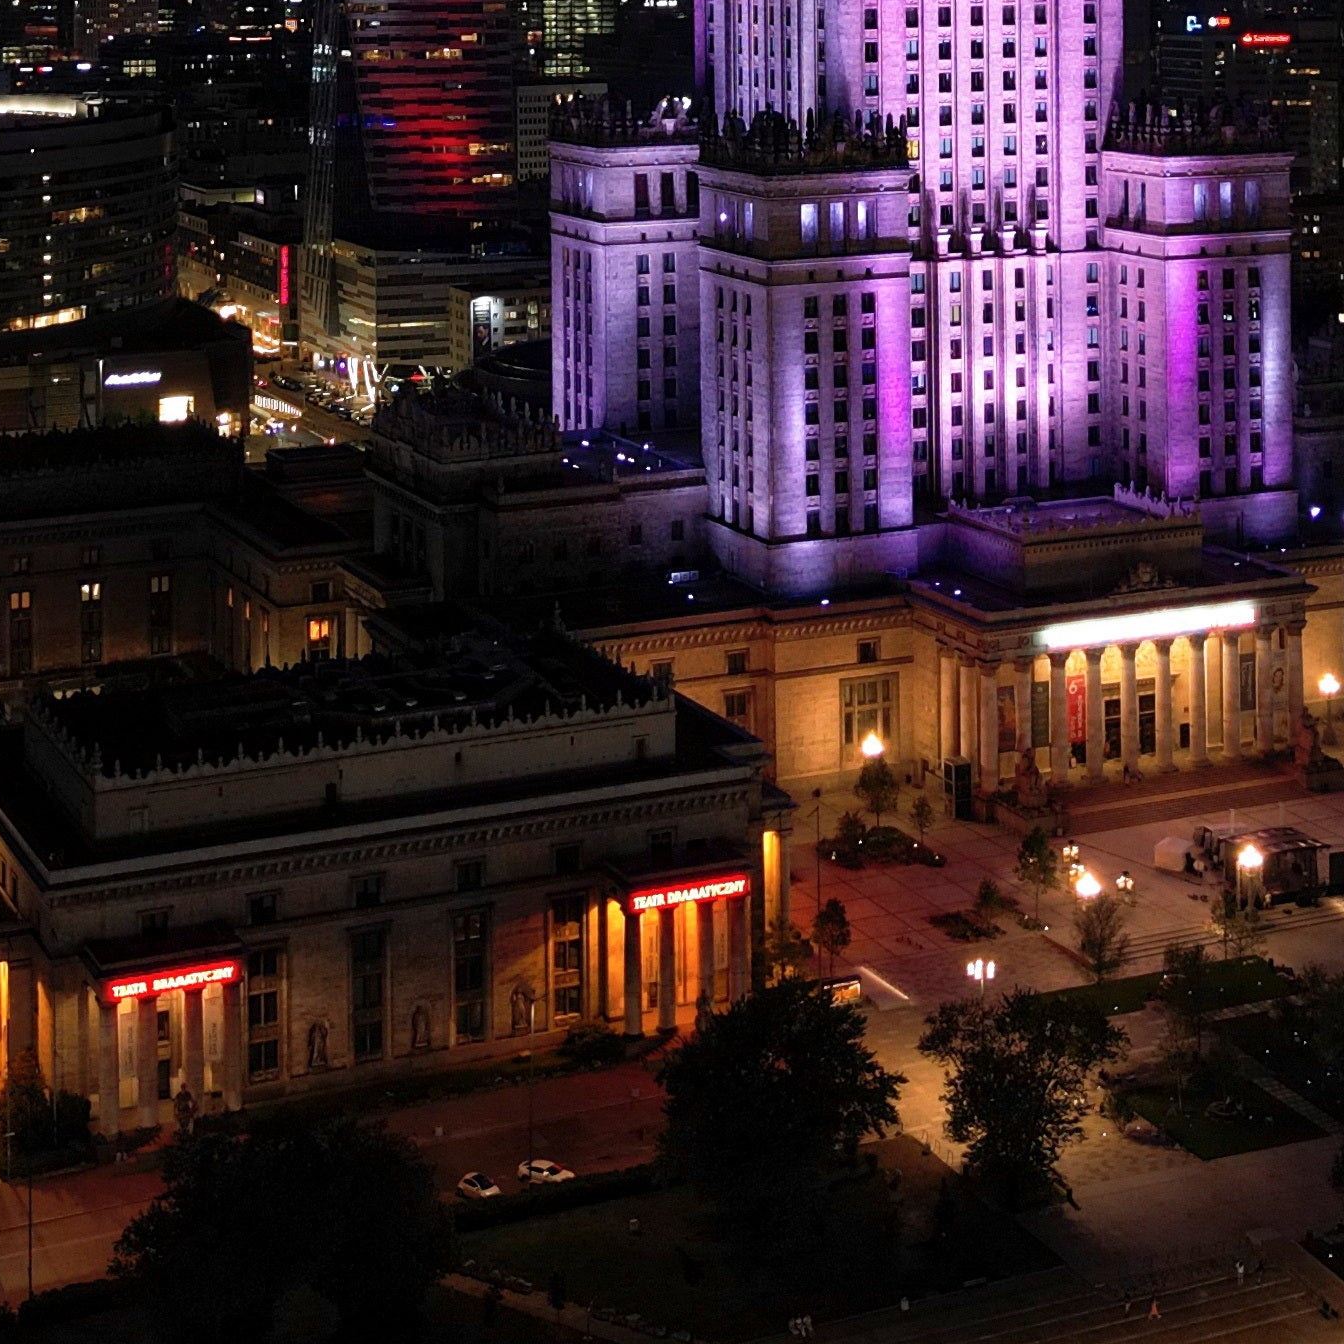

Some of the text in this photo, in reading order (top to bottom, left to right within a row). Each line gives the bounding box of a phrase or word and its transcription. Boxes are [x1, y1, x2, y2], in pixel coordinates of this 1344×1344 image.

[633, 879, 746, 910] TEATR DRAMATYCZNY
[112, 965, 234, 997] TEATR DRAMATYCZNY
